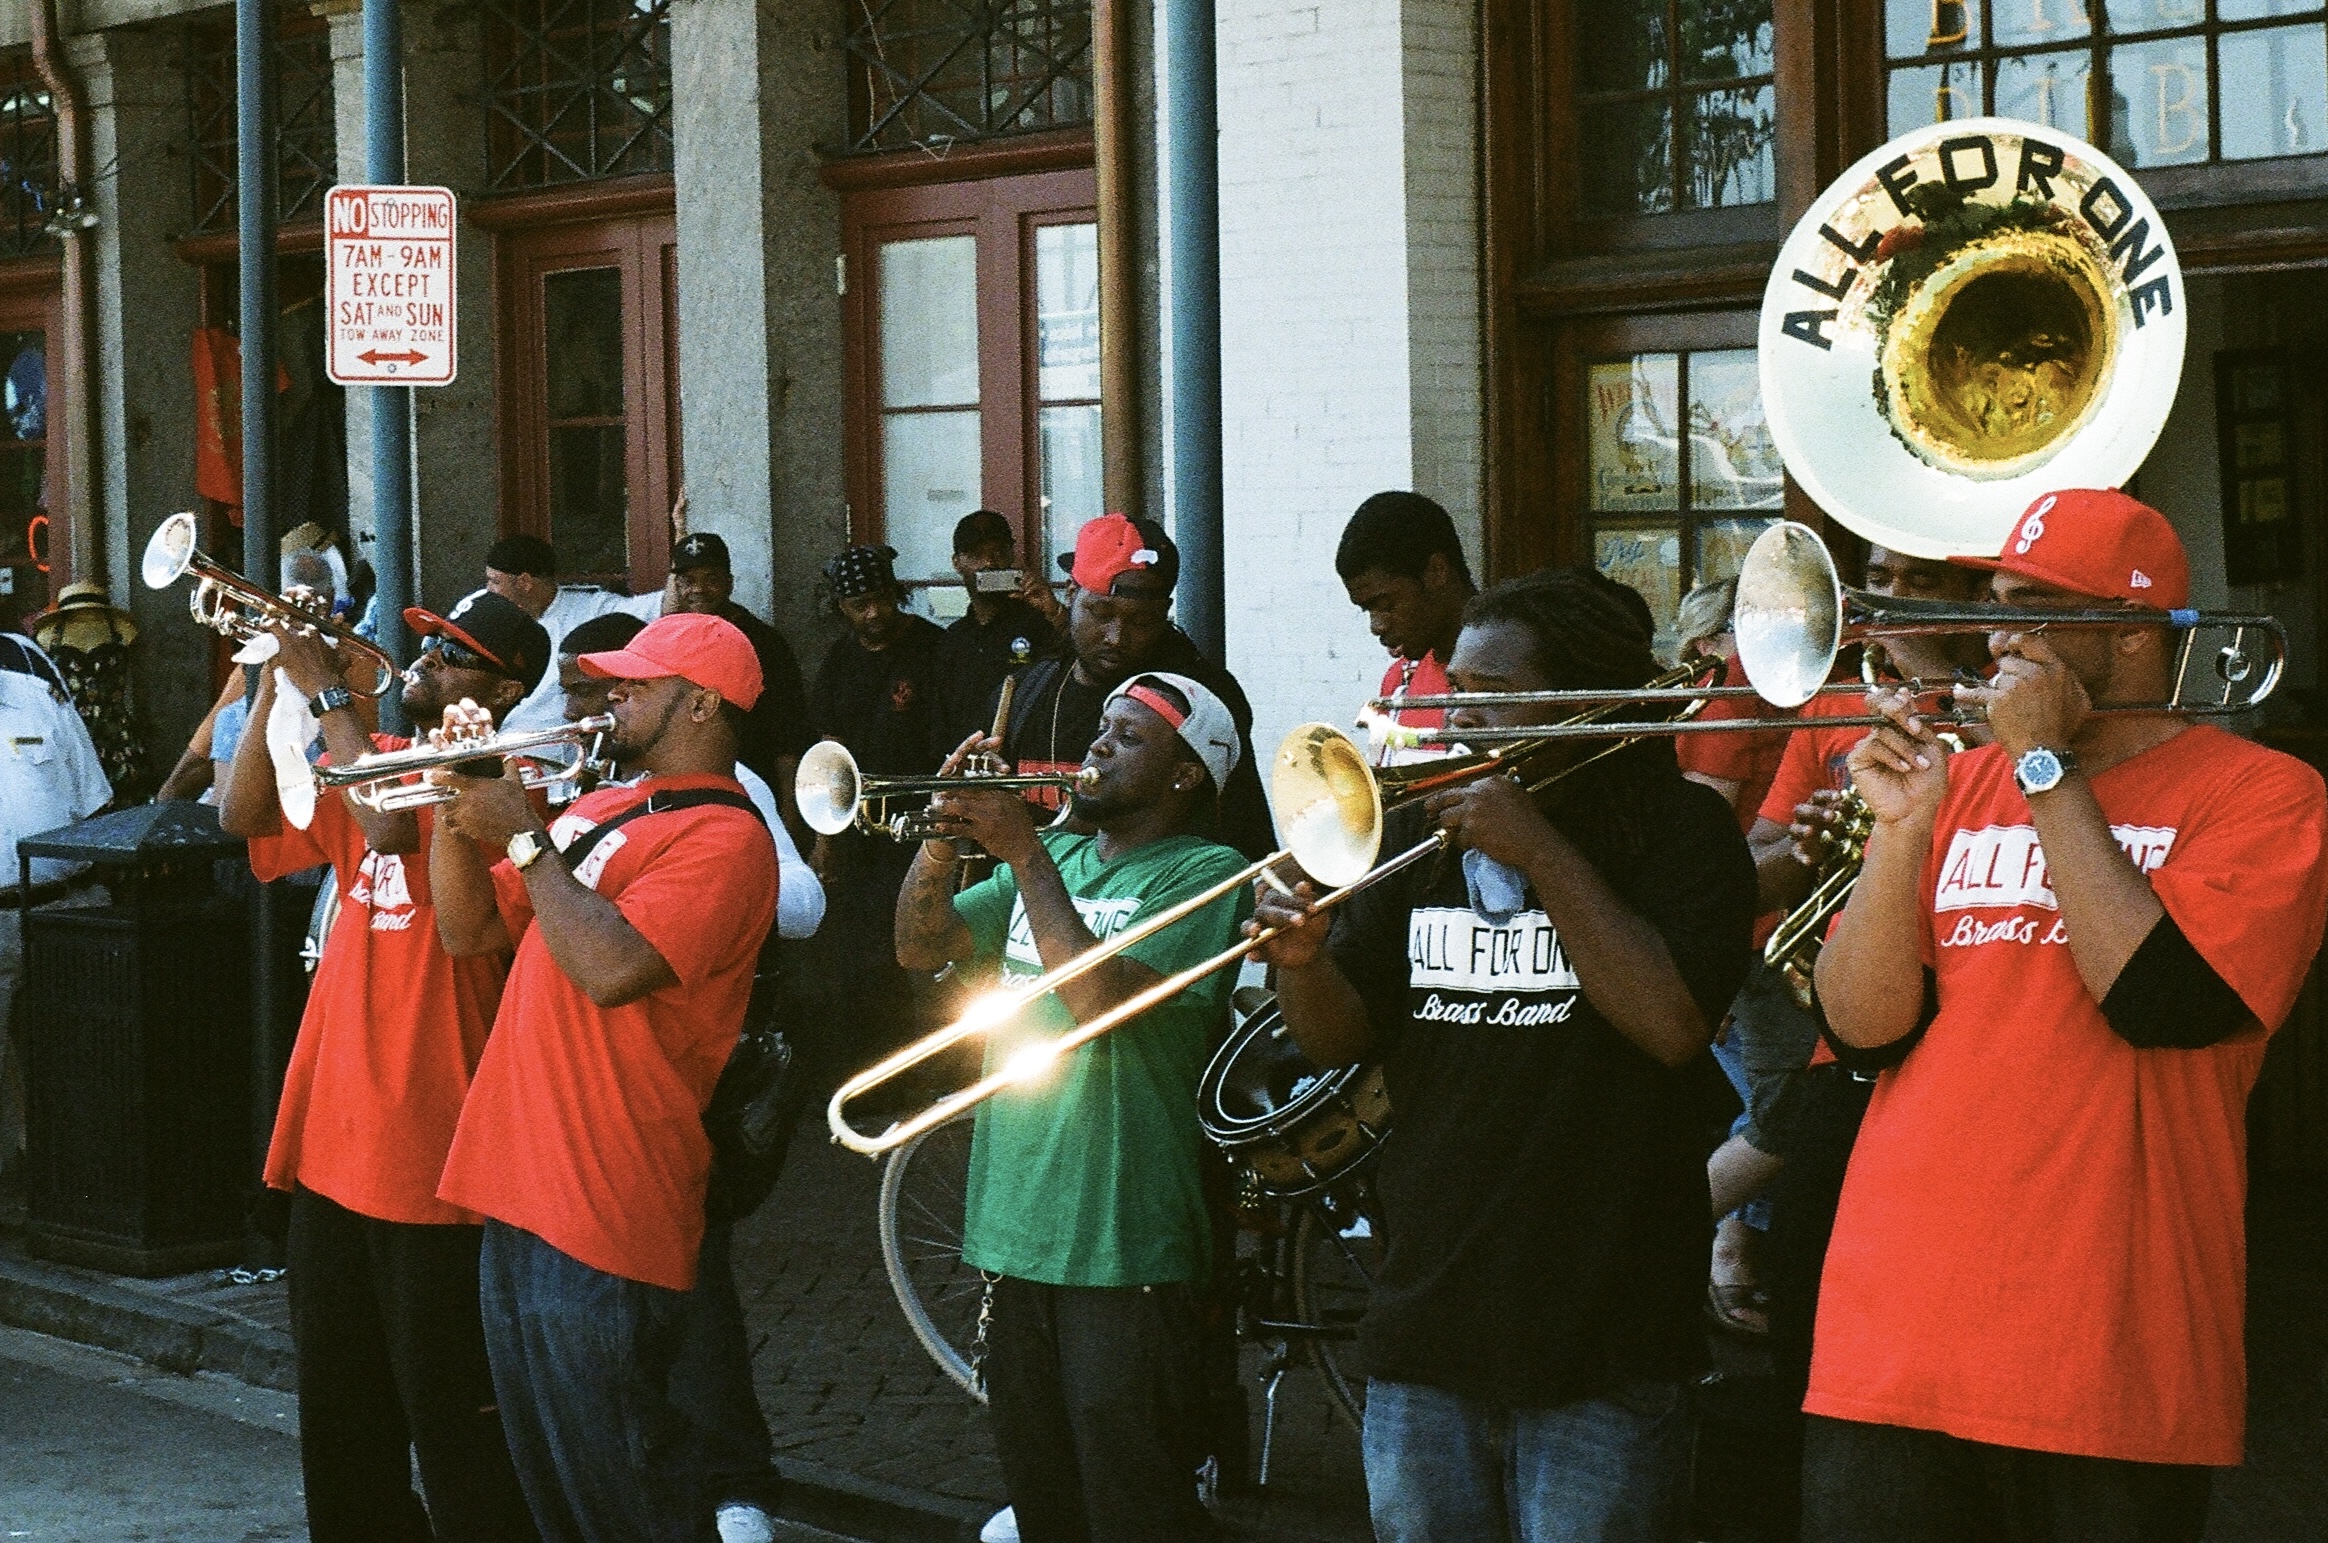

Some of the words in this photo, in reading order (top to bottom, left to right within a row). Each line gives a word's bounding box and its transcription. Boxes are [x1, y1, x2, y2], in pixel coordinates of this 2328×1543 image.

[333, 196, 367, 233] NO
[370, 202, 448, 228] STOPPING
[343, 245, 382, 268] 7AM
[400, 245, 441, 268] 9AM
[1781, 223, 1884, 352] ALL
[1876, 135, 2065, 218] FOR
[2079, 176, 2173, 330] ONE
[353, 273, 430, 297] EXCEPT
[340, 302, 374, 326] SAT
[377, 306, 402, 317] AND
[406, 302, 443, 327] SUN
[340, 329, 365, 341] TOW
[372, 329, 402, 341] AWAY
[411, 329, 444, 342] ZONE
[1941, 842, 2003, 893] ALL
[1941, 915, 2039, 947] Brass
[1414, 924, 1454, 972] ALL
[1470, 926, 1523, 976] FOR
[1533, 926, 1574, 974] ON
[1413, 993, 1488, 1025] Brass
[1486, 994, 1576, 1026] Band
